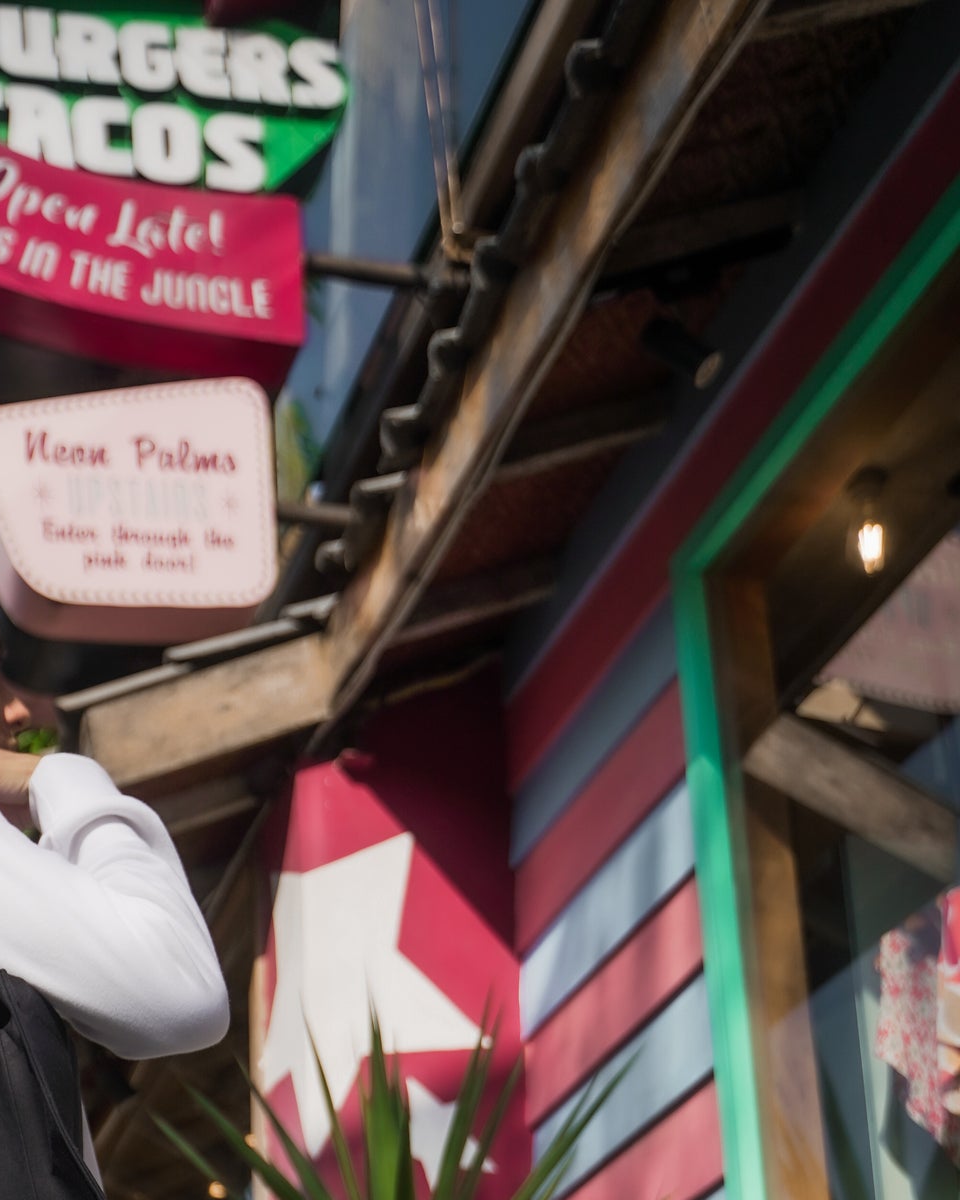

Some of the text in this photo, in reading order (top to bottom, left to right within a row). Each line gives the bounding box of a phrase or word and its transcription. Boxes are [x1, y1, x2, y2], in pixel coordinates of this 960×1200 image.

[105, 198, 227, 258] Late!
[68, 249, 131, 301] THE
[140, 270, 274, 320] JUNGLE
[25, 429, 238, 473] Neon Palms
